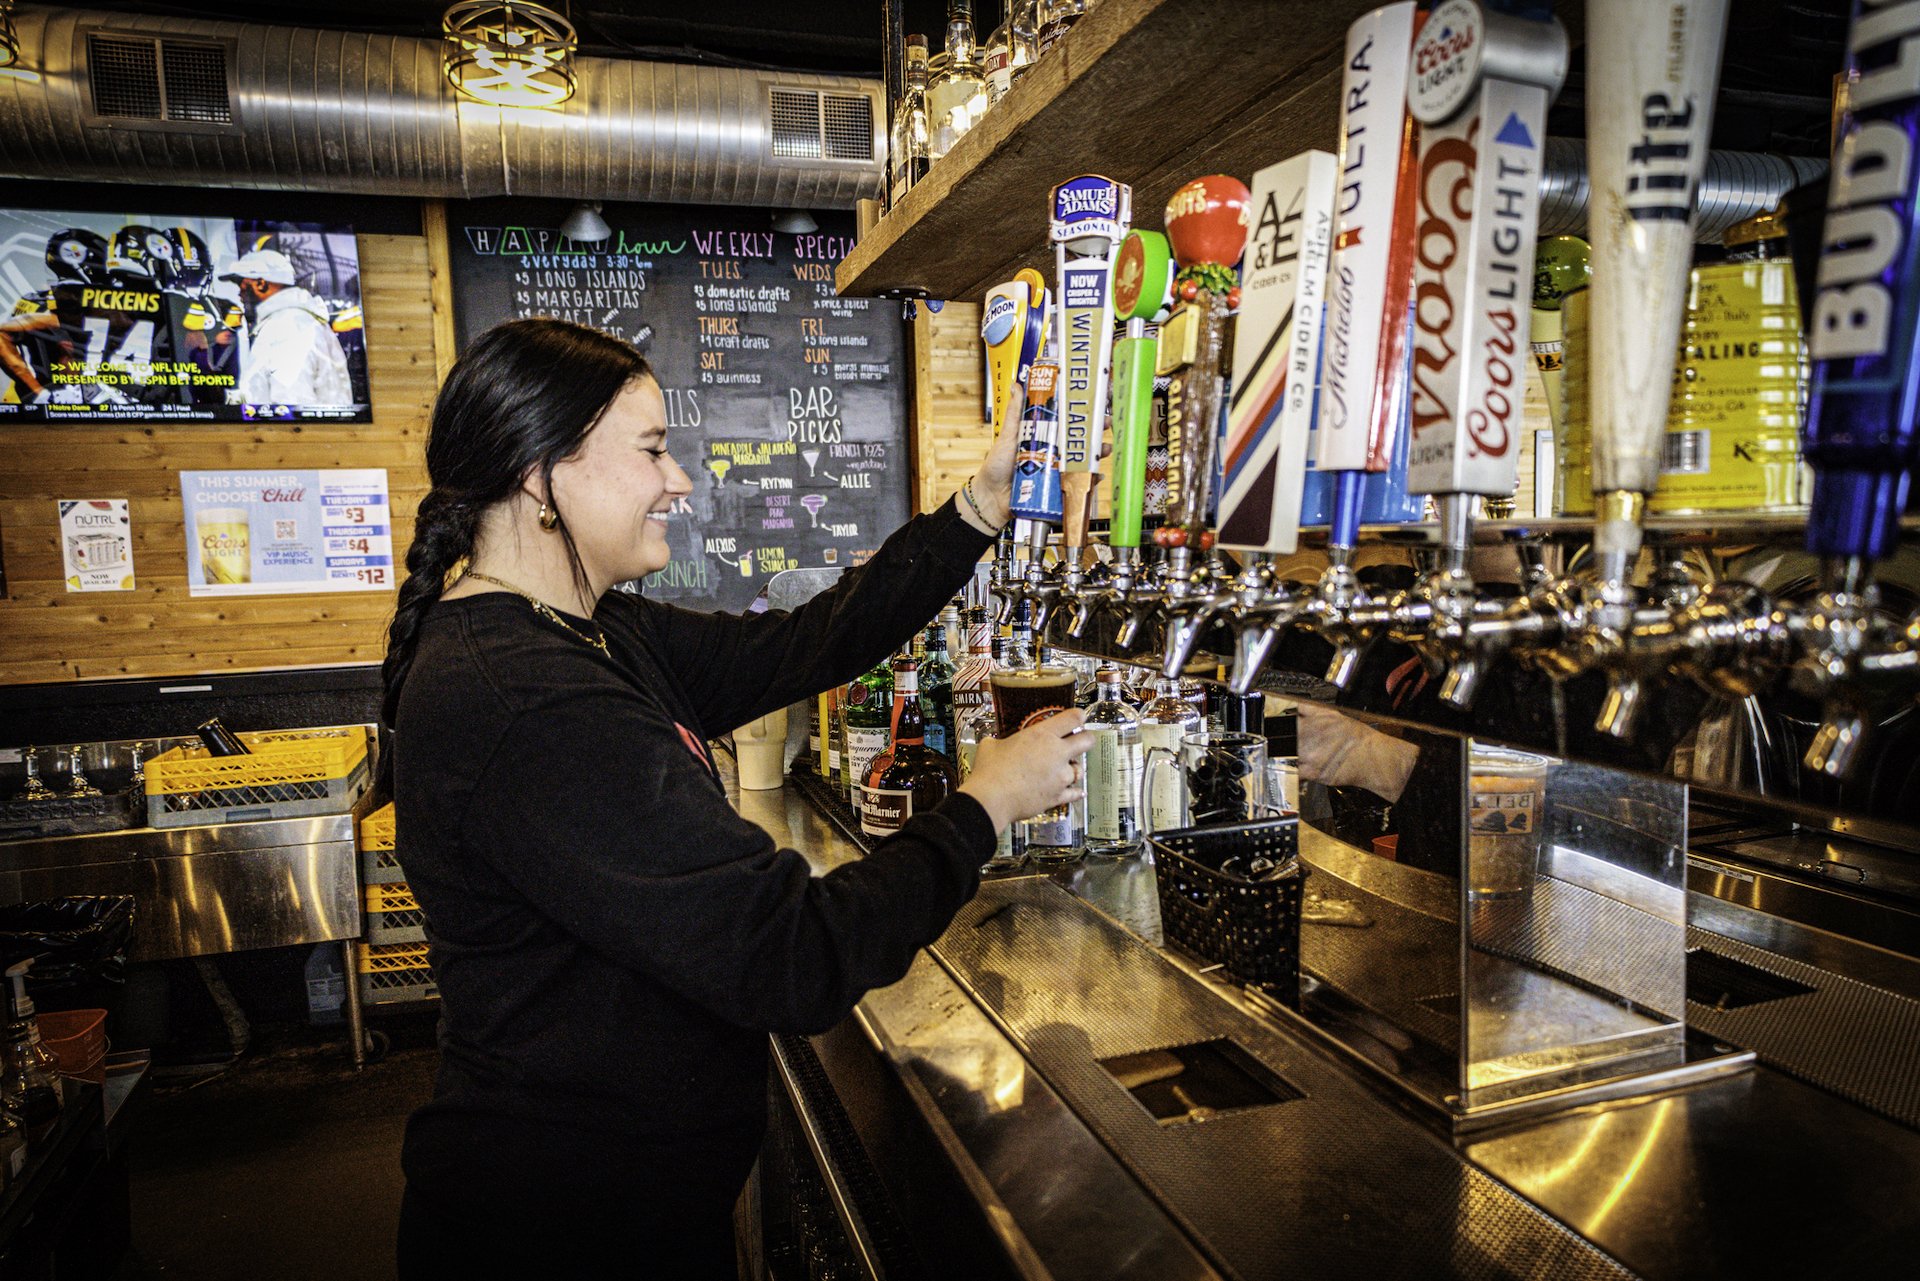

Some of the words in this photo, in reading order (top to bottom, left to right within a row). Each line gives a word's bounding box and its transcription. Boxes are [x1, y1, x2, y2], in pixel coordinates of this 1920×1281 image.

[1339, 37, 1375, 216] ULTRA
[1058, 186, 1114, 206] SAMUEL
[1060, 198, 1112, 218] ADAMS
[1056, 222, 1113, 239] SEASONAL
[1489, 156, 1529, 300] LIGHT
[692, 229, 774, 258] WEEKLY
[1813, 119, 1914, 361] BUD
[521, 255, 597, 269] everyday
[536, 271, 577, 288] LONG
[586, 270, 646, 291] ISLANDS
[1069, 275, 1099, 289] NOW
[82, 288, 162, 314] PICKENS
[536, 289, 640, 309] MARGARITAS
[706, 285, 756, 299] domestic
[757, 286, 791, 303] drafts
[709, 299, 736, 313] long
[737, 299, 779, 314] islands
[991, 300, 1015, 320] MOON
[82, 316, 157, 382] 14
[741, 336, 771, 350] drafts
[1068, 312, 1093, 391] WINTER
[67, 361, 127, 373] WELCOME
[133, 362, 150, 373] TO
[151, 362, 173, 374] NFL
[173, 363, 203, 375] LIVE,
[1030, 367, 1055, 379] SUN
[52, 373, 119, 386] PRESENTED
[119, 374, 137, 386] BY
[170, 375, 191, 387] BET
[192, 375, 236, 387] SPORTS
[716, 372, 763, 385] guinness
[1029, 378, 1053, 389] KING
[1466, 306, 1517, 459] Coors
[789, 385, 838, 420] BAR
[993, 359, 1003, 438] BELGIAN
[786, 419, 843, 444] PICKS
[1064, 400, 1090, 464] LAGER
[198, 476, 231, 489] THIS
[233, 475, 303, 489] SUMMER,
[839, 472, 872, 490] ALLIE
[196, 490, 258, 504] CHOOSE
[261, 487, 307, 503] Chill
[346, 507, 365, 523] $3
[830, 523, 859, 538] TAYLOR
[201, 534, 247, 550] Coors
[349, 538, 369, 554] $4
[705, 537, 737, 554] ALEXUS
[207, 548, 244, 559] LIGHT
[262, 557, 315, 566] EXPERIENCE
[266, 550, 281, 559] VIP
[281, 550, 310, 559] MUSIC
[757, 547, 785, 561] LEMON
[357, 569, 385, 585] $12
